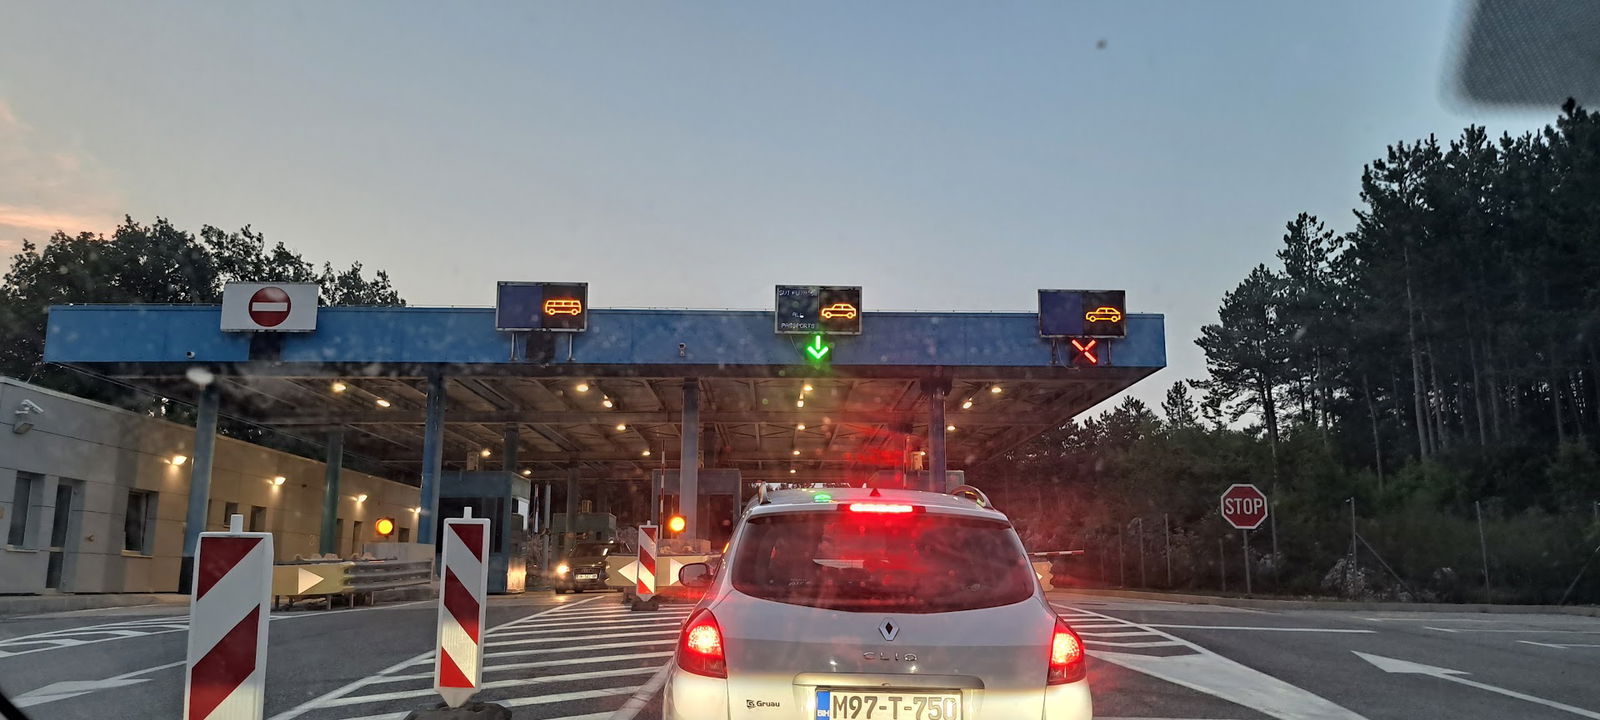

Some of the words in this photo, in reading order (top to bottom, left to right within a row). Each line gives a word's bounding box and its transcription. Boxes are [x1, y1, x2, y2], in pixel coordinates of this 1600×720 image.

[1225, 498, 1263, 515] STOP
[864, 651, 917, 662] CLIO
[833, 695, 957, 719] M97-T-750
